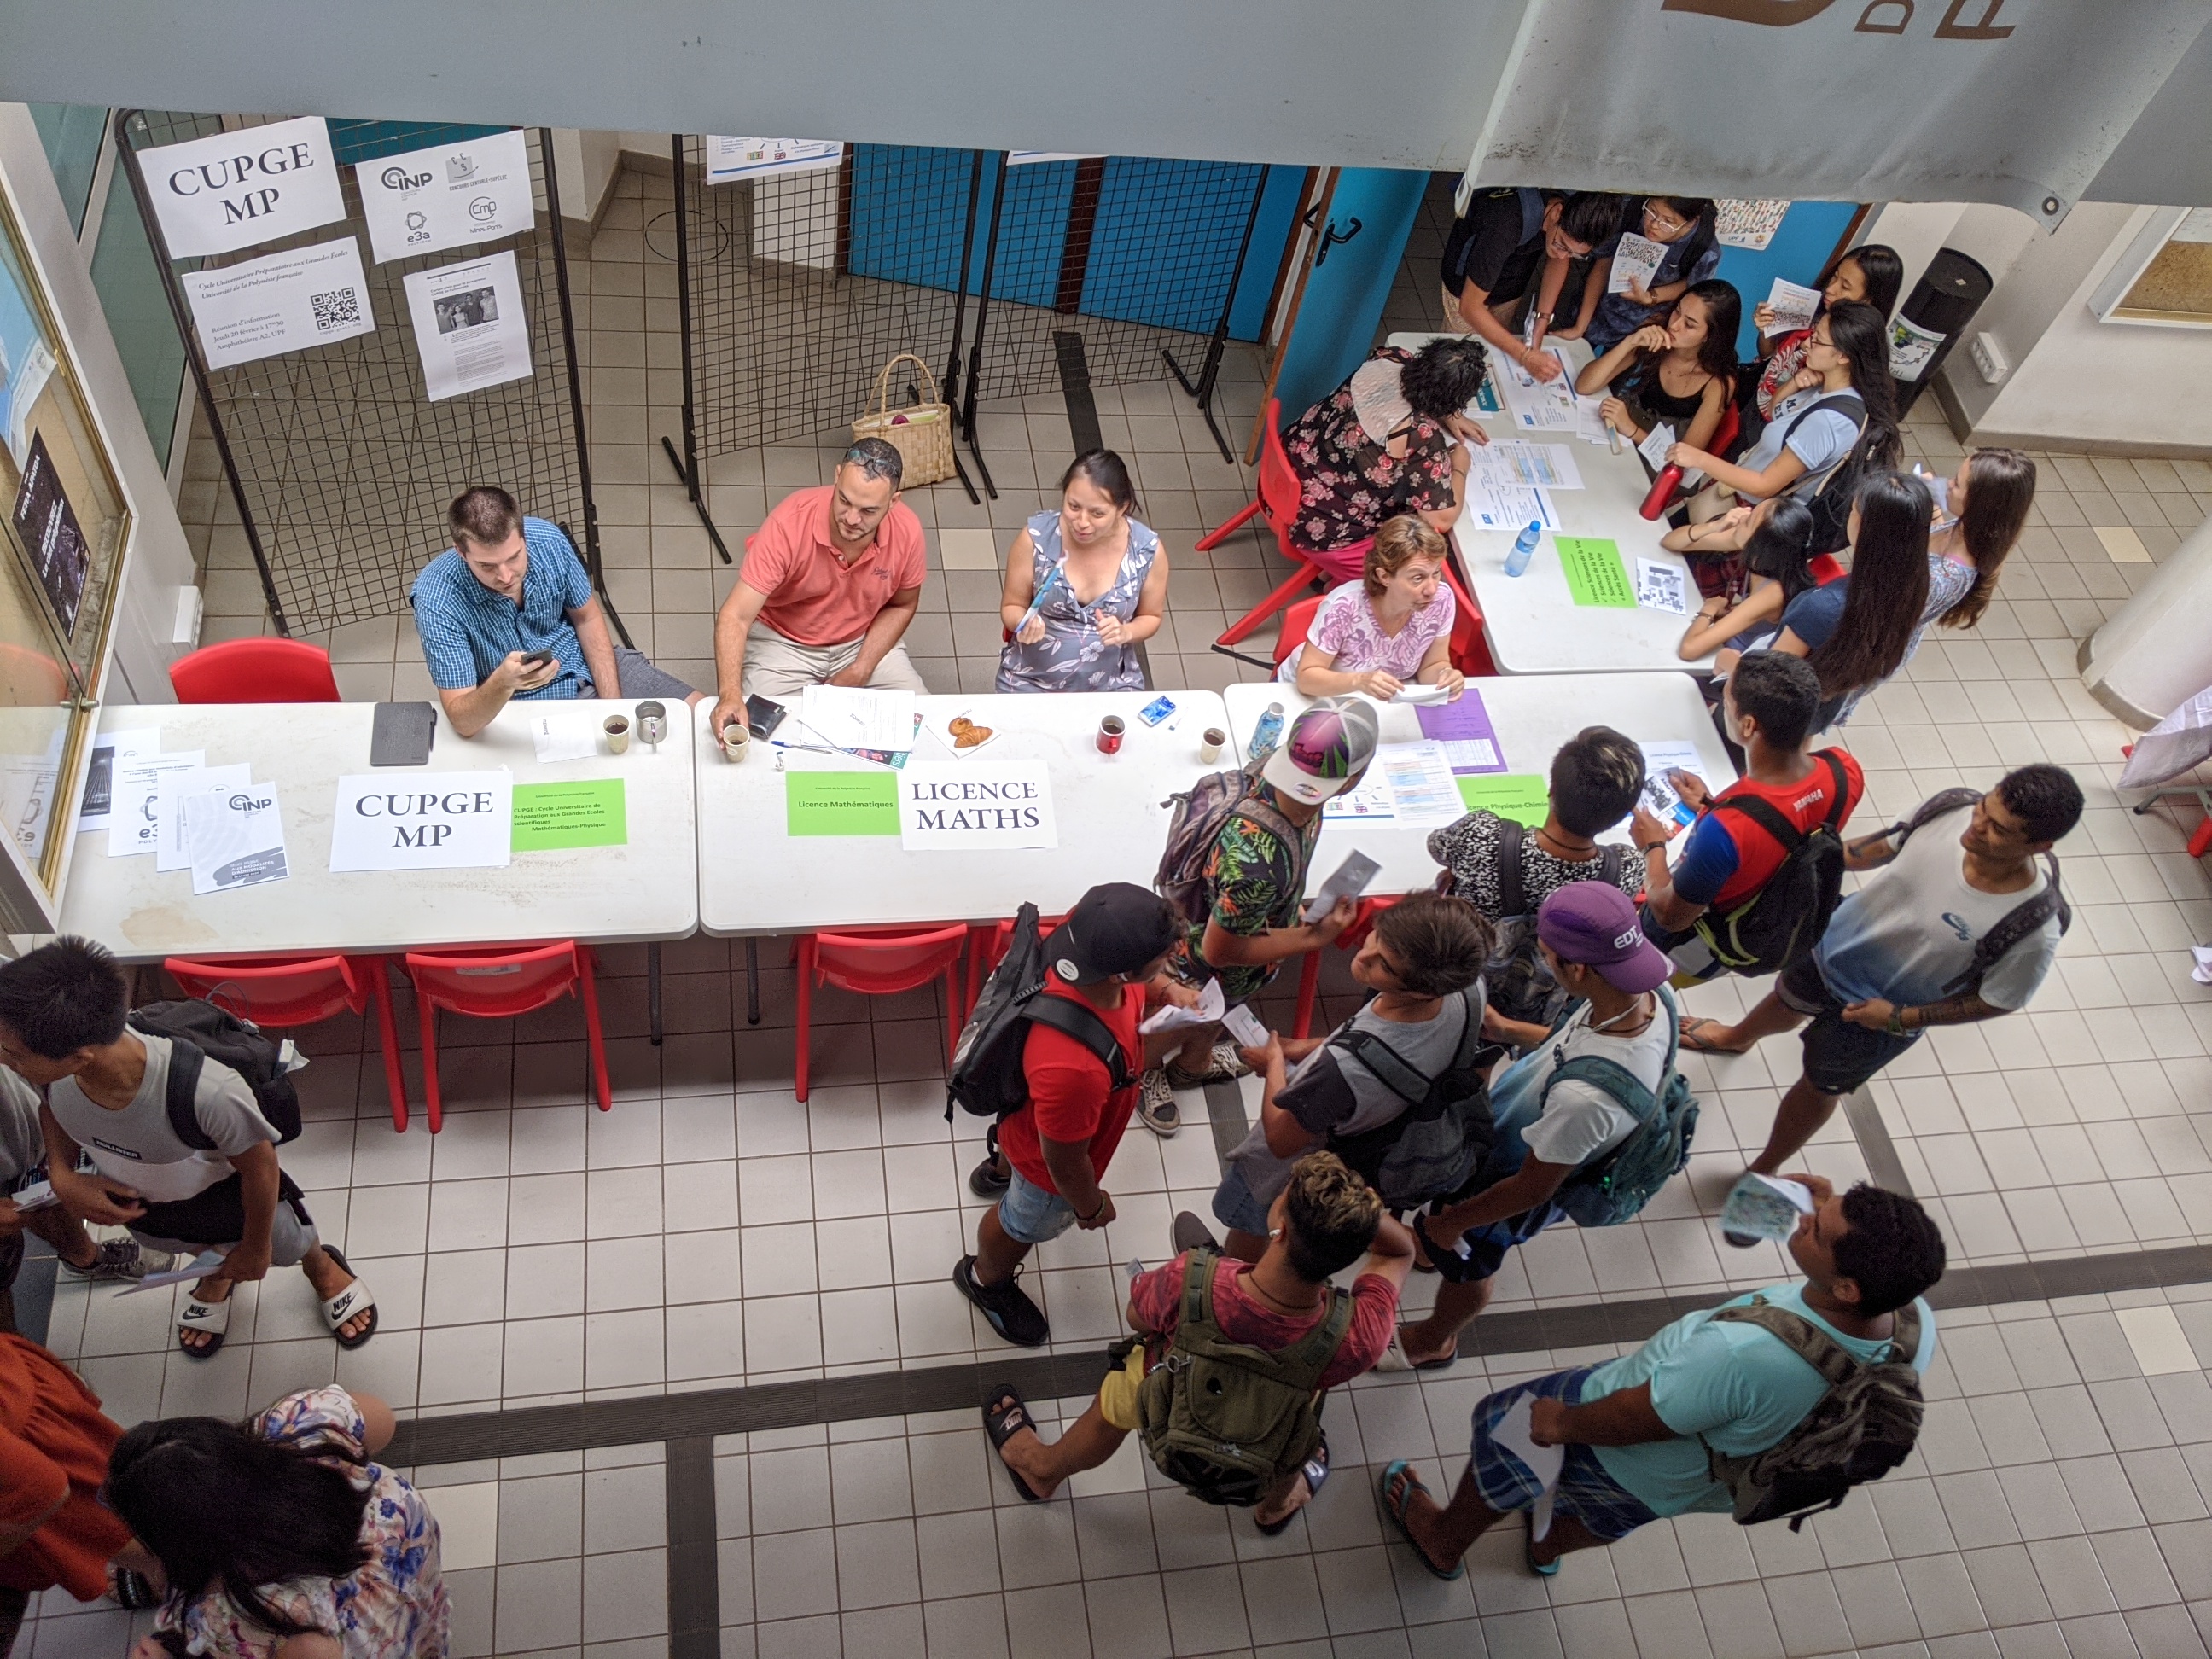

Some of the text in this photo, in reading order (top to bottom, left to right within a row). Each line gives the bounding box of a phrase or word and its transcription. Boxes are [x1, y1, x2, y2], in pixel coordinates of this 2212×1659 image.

[169, 142, 315, 196] CUPGE
[219, 188, 280, 226] MP
[407, 231, 431, 242] e3a
[198, 282, 215, 291] Cycle
[216, 272, 255, 287] Universitaire
[255, 263, 292, 275] Préparatoire
[305, 254, 330, 264] Grandes
[201, 287, 233, 299] Université
[248, 275, 276, 287] Polynésie
[276, 271, 303, 282] française
[211, 312, 280, 333] Réunion d'information
[213, 333, 230, 343] Jeudi
[239, 327, 259, 335] février
[216, 336, 258, 351] Amphithéâtre
[271, 329, 286, 337] UPF
[20, 492, 32, 521] FETIA
[28, 454, 41, 492] APATOA
[42, 563, 49, 579] Le
[46, 545, 55, 565] ciel
[1583, 562, 1593, 584] Sciences
[1610, 567, 1620, 581] Santé
[1589, 584, 1600, 603] Licence
[1595, 574, 1607, 596] Sciences
[1605, 574, 1616, 596] Sciences
[1616, 582, 1625, 596] Accès
[911, 782, 1039, 800] LICENCE
[1793, 788, 1824, 812] YAMAHA
[354, 791, 494, 817] CUPGE
[830, 801, 894, 809] Mathématiques
[1490, 802, 1548, 810] Physique-Chimie
[532, 822, 606, 832] Mathématiques-Physique
[916, 806, 1040, 830] MATHS
[390, 824, 452, 848] MP
[244, 860, 274, 869] MODALITÉS
[1613, 925, 1637, 949] EDT
[96, 1140, 138, 1158] HOLLISTER
[187, 1304, 209, 1317] NIKE
[332, 1291, 352, 1312] NIKE
[1004, 1412, 1023, 1431] NIKE
